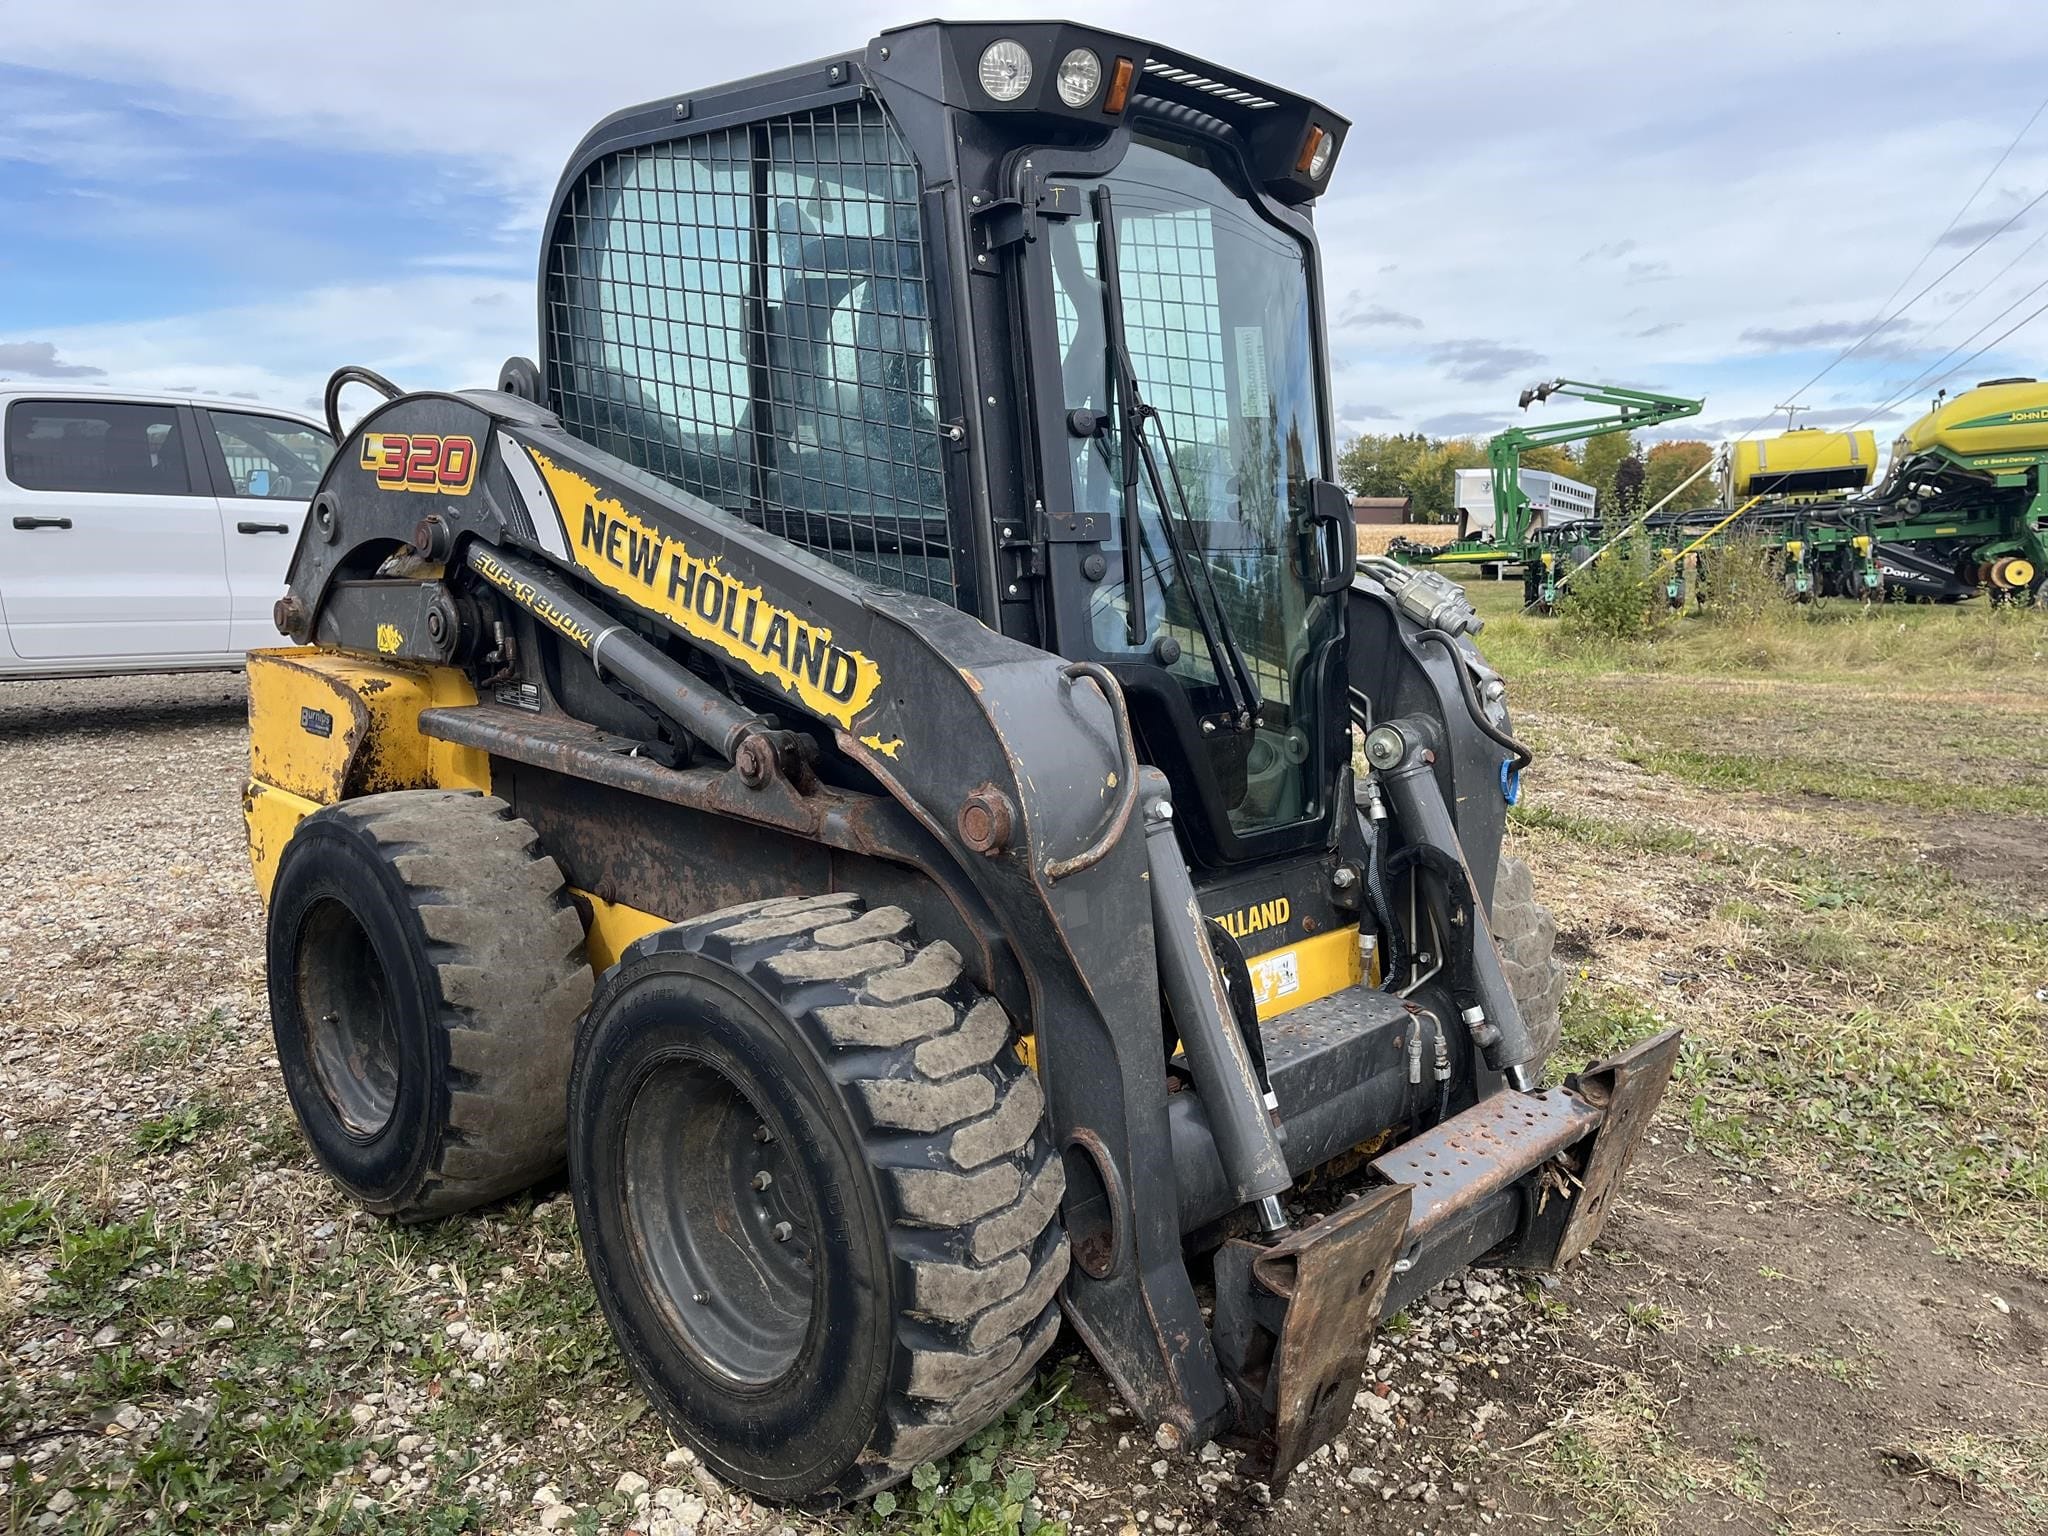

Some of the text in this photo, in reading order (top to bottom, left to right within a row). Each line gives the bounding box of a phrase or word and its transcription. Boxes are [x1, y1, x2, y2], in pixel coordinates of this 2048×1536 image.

[2009, 411, 2040, 421] JOHN
[361, 434, 476, 493] L320
[474, 552, 594, 648] SUPER BOOM
[581, 503, 857, 702] NEW HOLLAND
